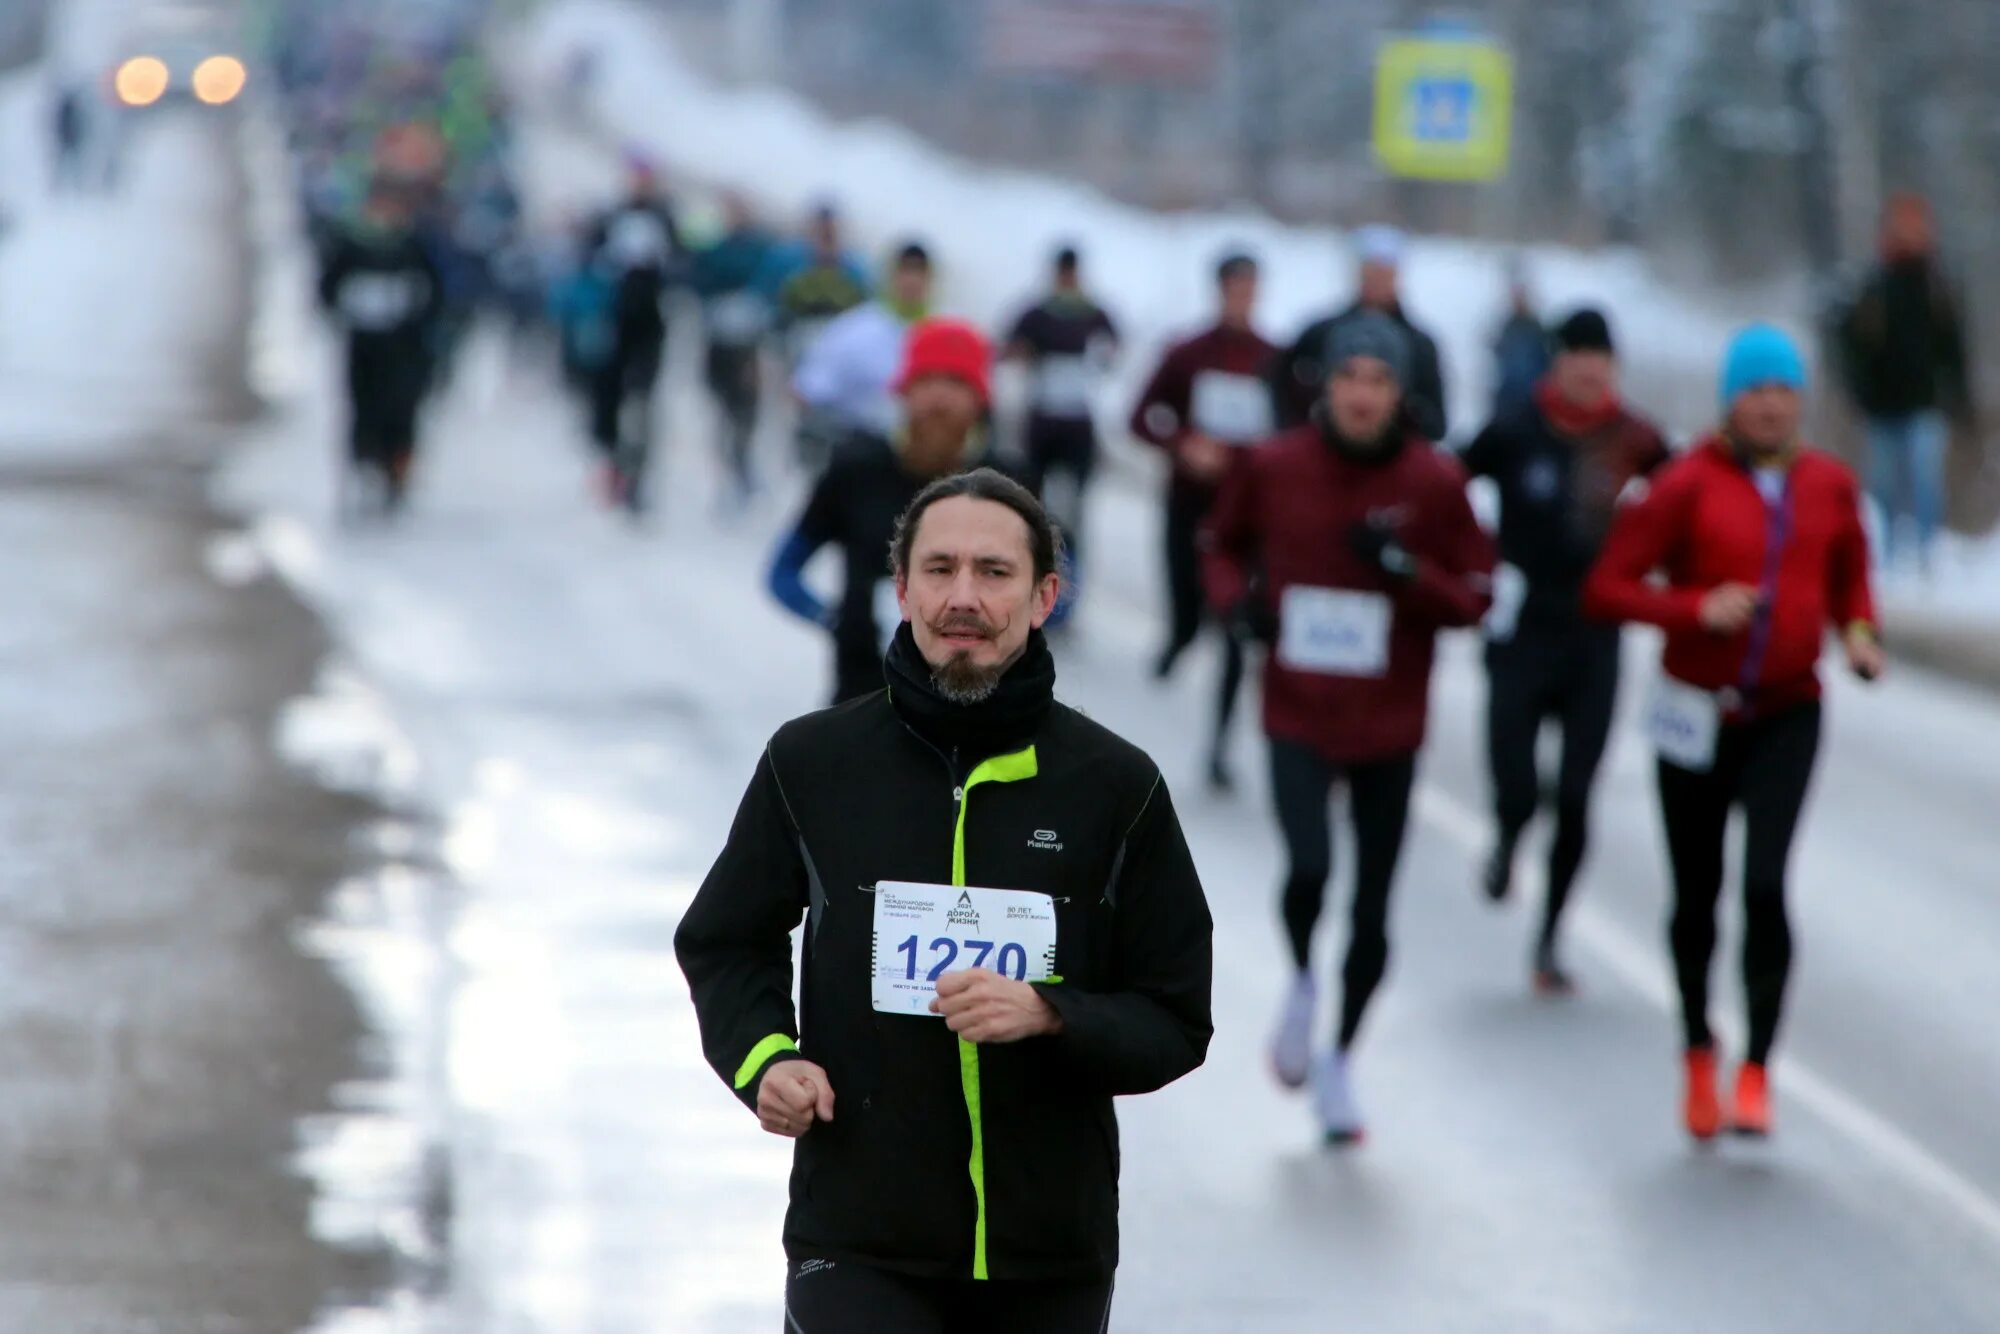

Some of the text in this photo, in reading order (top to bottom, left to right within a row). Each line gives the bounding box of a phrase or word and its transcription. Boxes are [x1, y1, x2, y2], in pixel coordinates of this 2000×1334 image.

[1027, 840, 1063, 852] Kalenji
[947, 910, 980, 919] ДОРОГА
[948, 917, 978, 925] ЖИЗНИ
[897, 935, 1027, 982] 1270
